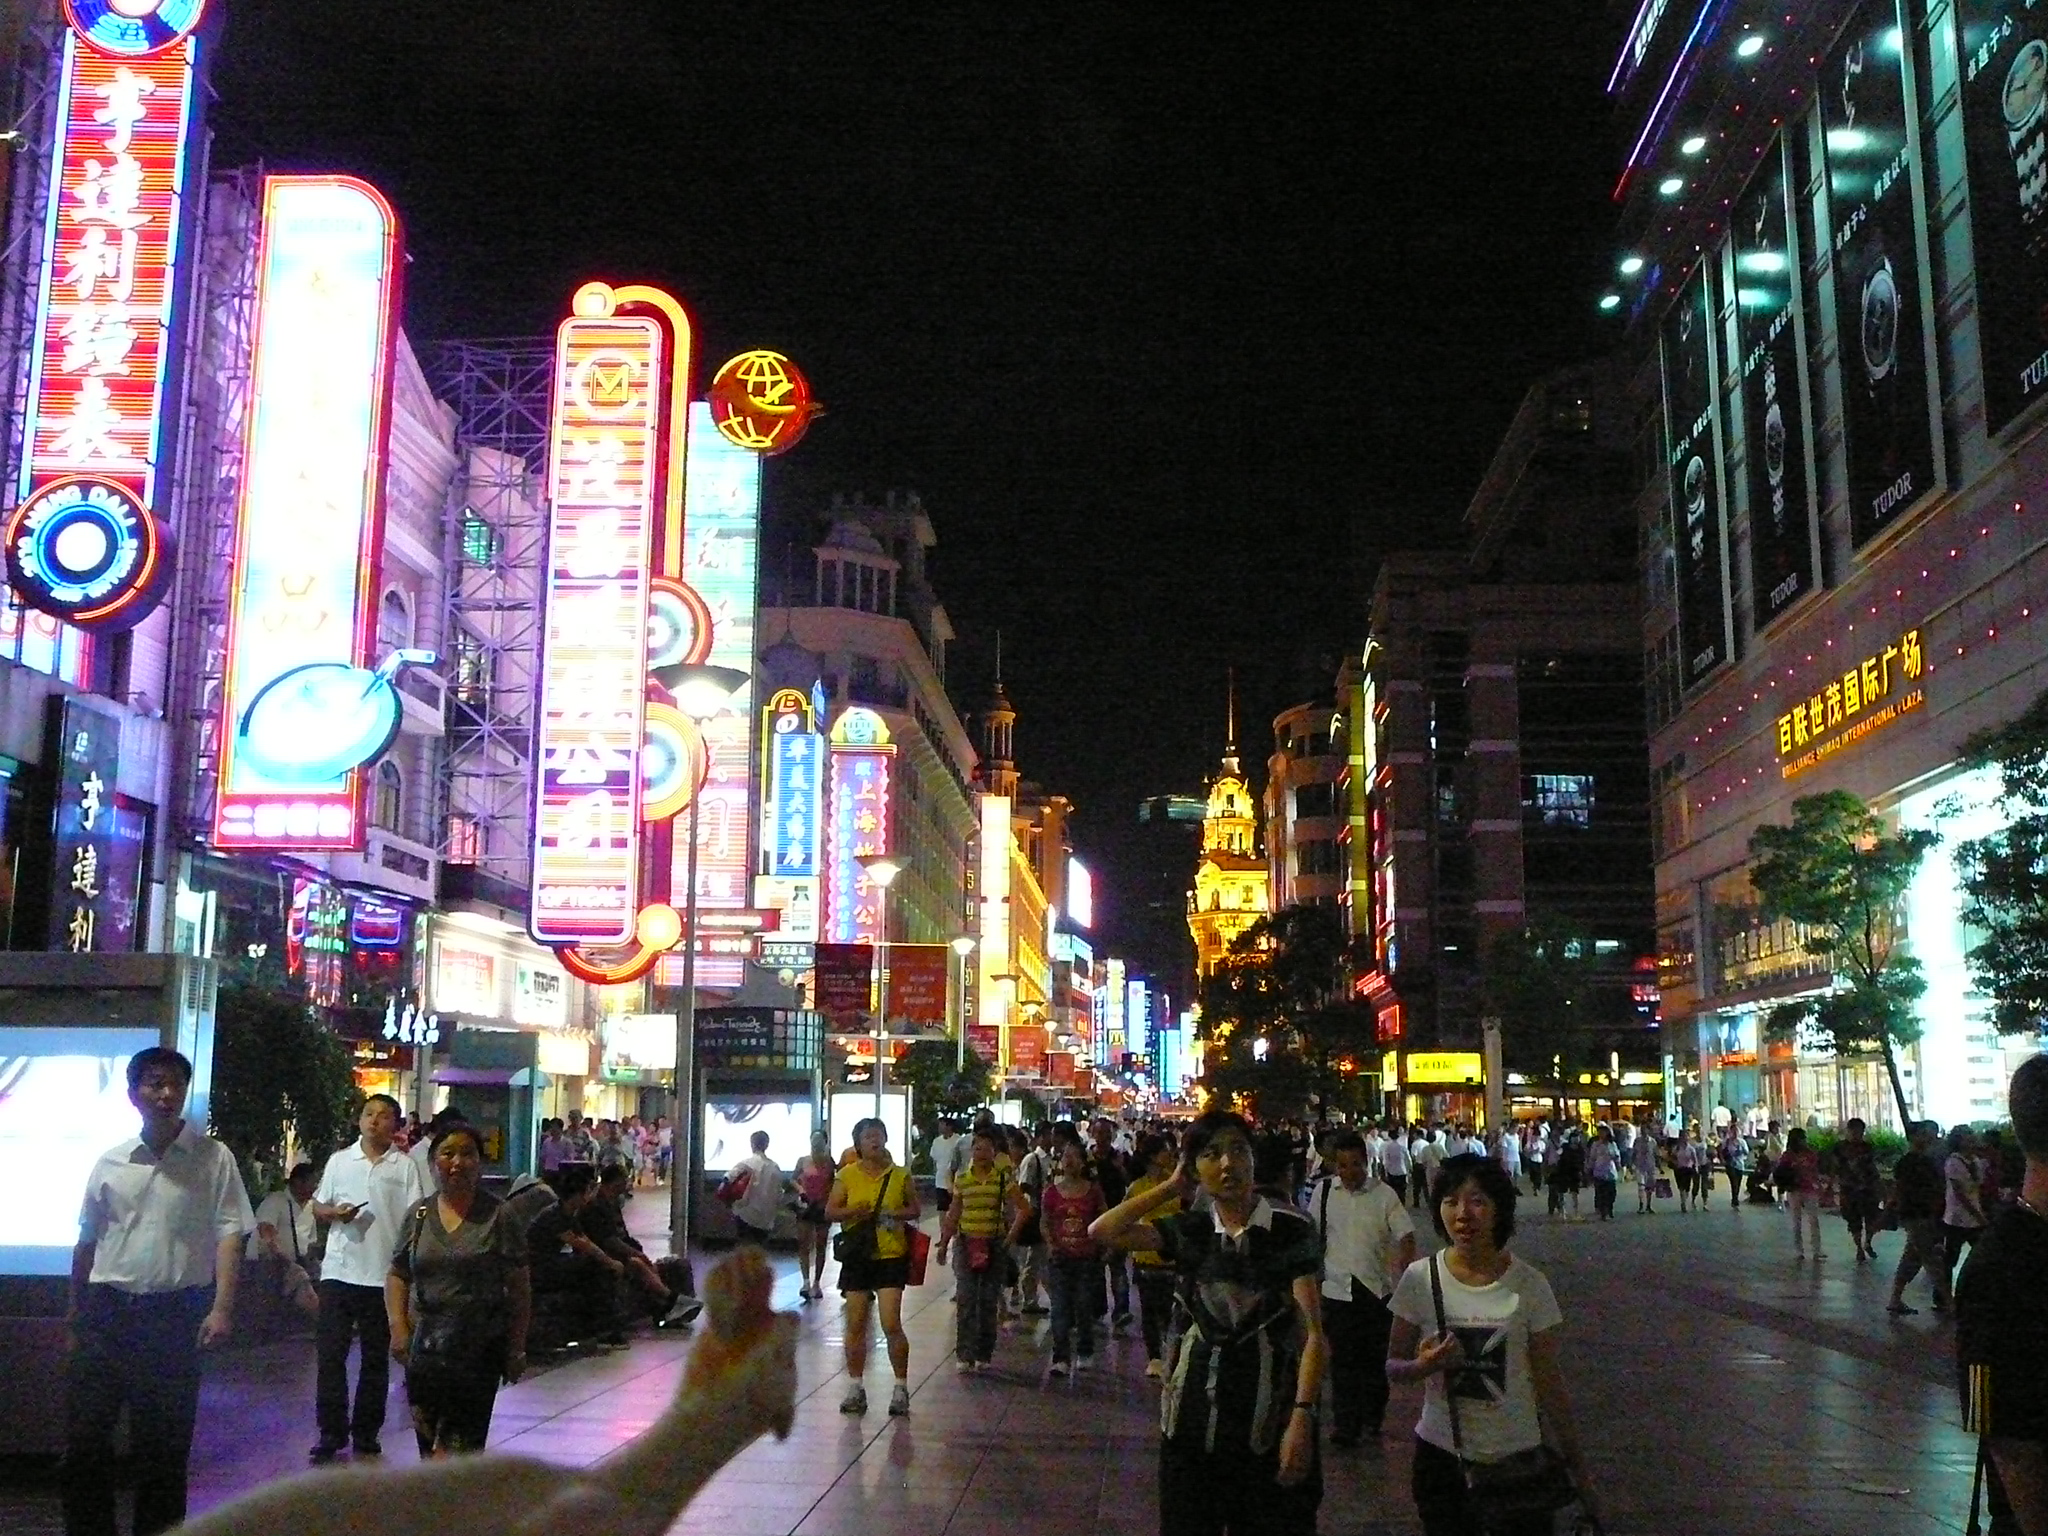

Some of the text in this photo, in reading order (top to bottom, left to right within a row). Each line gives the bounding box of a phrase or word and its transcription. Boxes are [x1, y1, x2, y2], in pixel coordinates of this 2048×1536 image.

[1872, 472, 1912, 519] TUDOR
[1770, 572, 1798, 609] TUDOR
[1778, 630, 1922, 754] 百联世茂国际广场
[1782, 752, 1816, 779] BRILLIANCE
[1841, 705, 1896, 745] INTERNATIONAL
